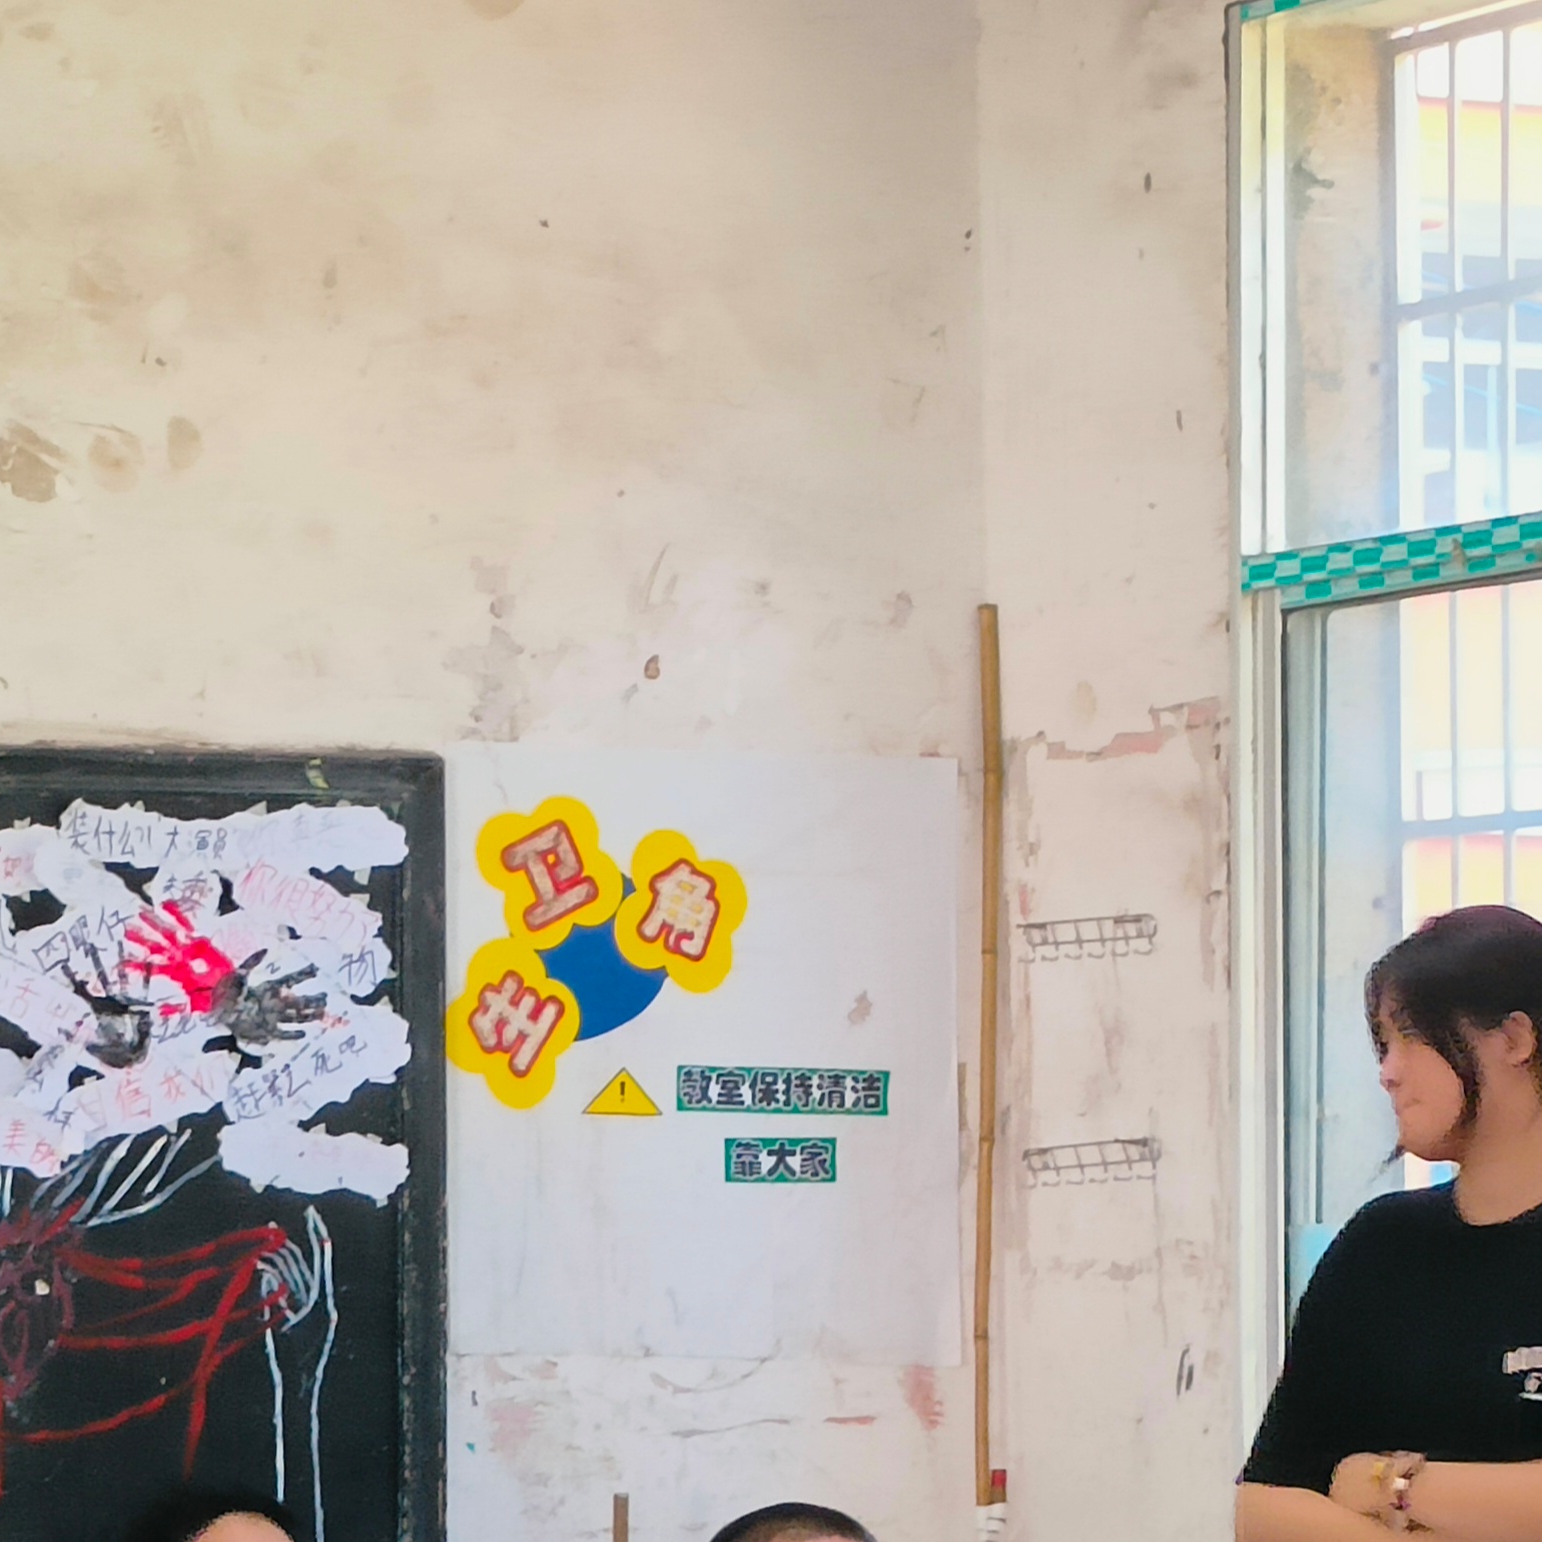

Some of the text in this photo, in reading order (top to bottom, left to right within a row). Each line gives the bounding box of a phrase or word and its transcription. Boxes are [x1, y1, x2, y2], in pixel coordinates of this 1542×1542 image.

[680, 1069, 886, 1112] 教室保持清洁
[729, 1140, 833, 1179] 靠大家
